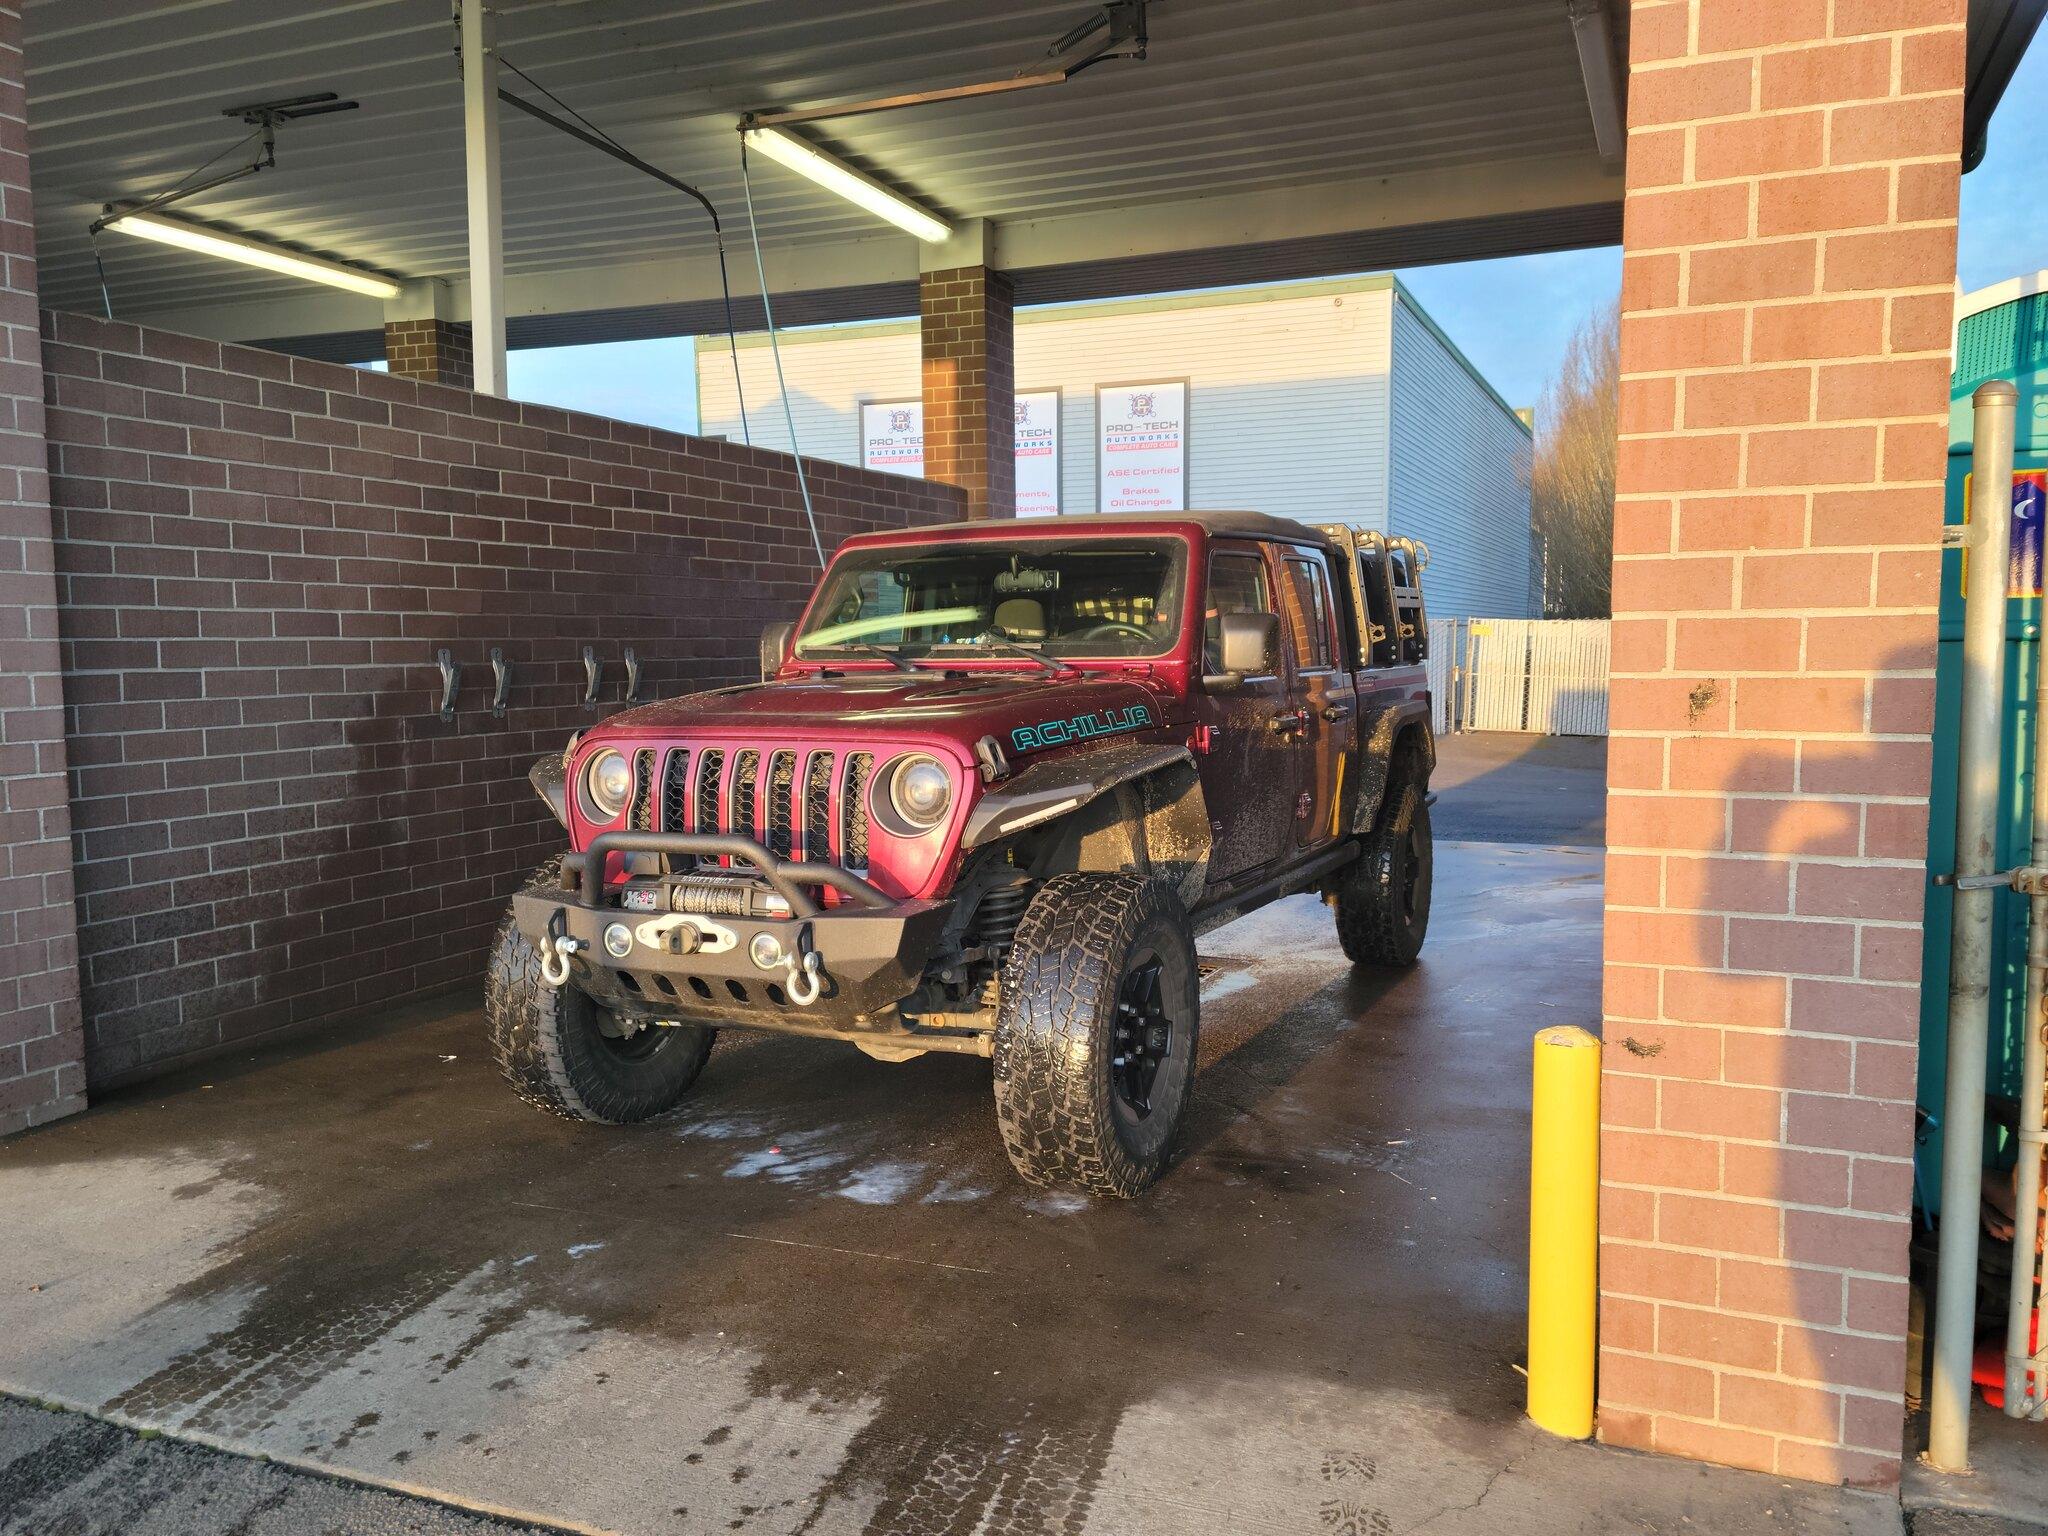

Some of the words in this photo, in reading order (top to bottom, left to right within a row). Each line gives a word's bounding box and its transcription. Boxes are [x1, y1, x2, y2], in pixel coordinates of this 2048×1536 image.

[1018, 428, 1052, 437] TECH
[869, 437, 923, 446] PRO-TEC
[1106, 433, 1179, 443] AUTOWORKS
[1015, 440, 1052, 448] WORKS
[1107, 468, 1131, 477] ASE
[1132, 466, 1180, 476] Certified
[1111, 499, 1125, 507] Oil
[1126, 498, 1172, 507] Changes
[1011, 704, 1155, 750] ACHILLIA
